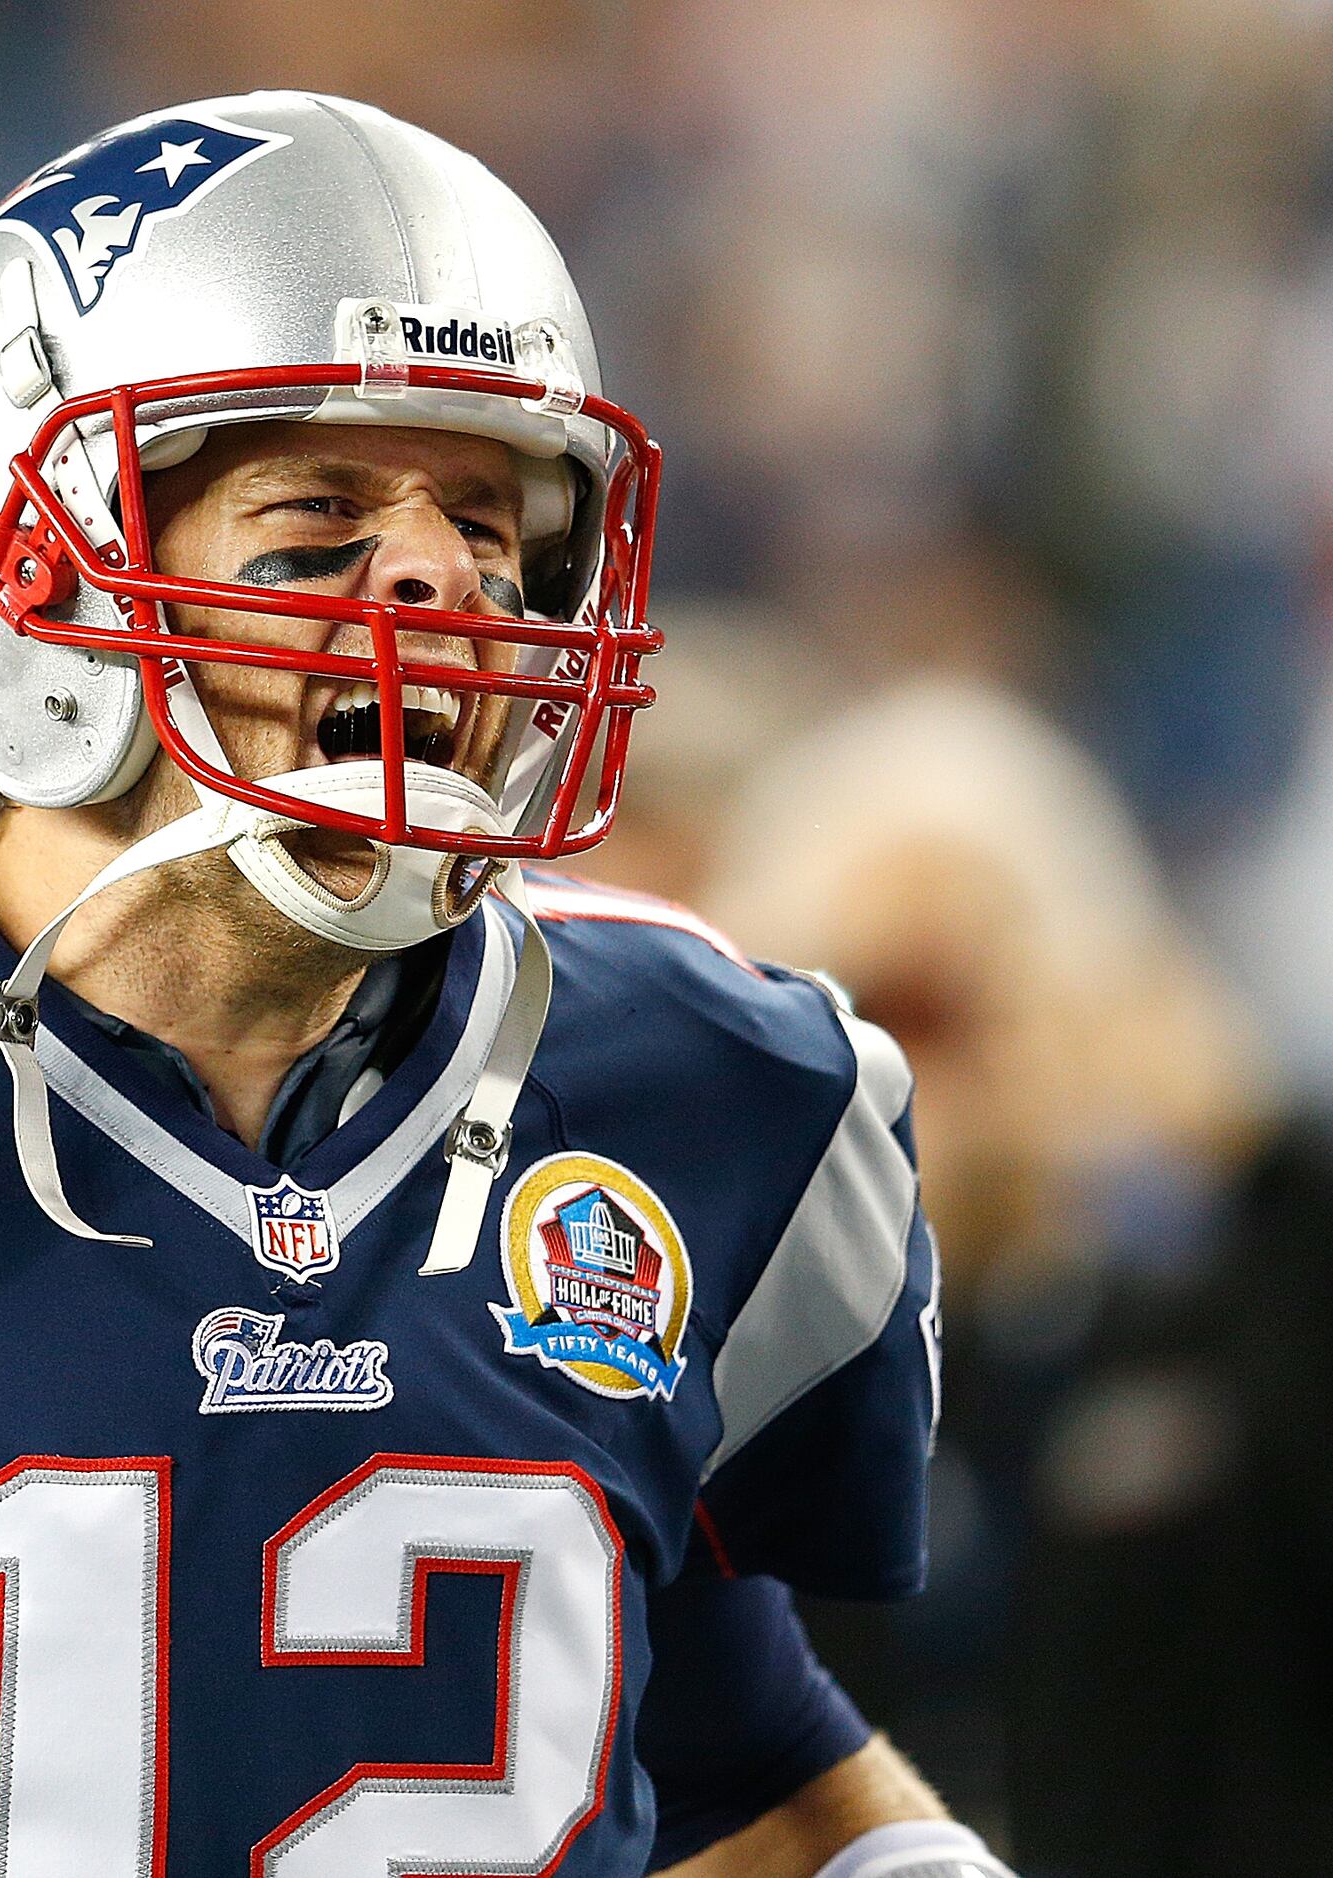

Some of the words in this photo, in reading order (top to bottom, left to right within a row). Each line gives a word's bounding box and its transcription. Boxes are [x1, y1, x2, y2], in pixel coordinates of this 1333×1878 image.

[265, 1220, 327, 1265] NFL
[556, 1277, 601, 1309] HALL
[599, 1289, 611, 1304] OF
[611, 1291, 653, 1326] FAME
[201, 1338, 388, 1406] Patriots
[547, 1335, 599, 1352] FIFTY
[604, 1341, 658, 1383] YEARS
